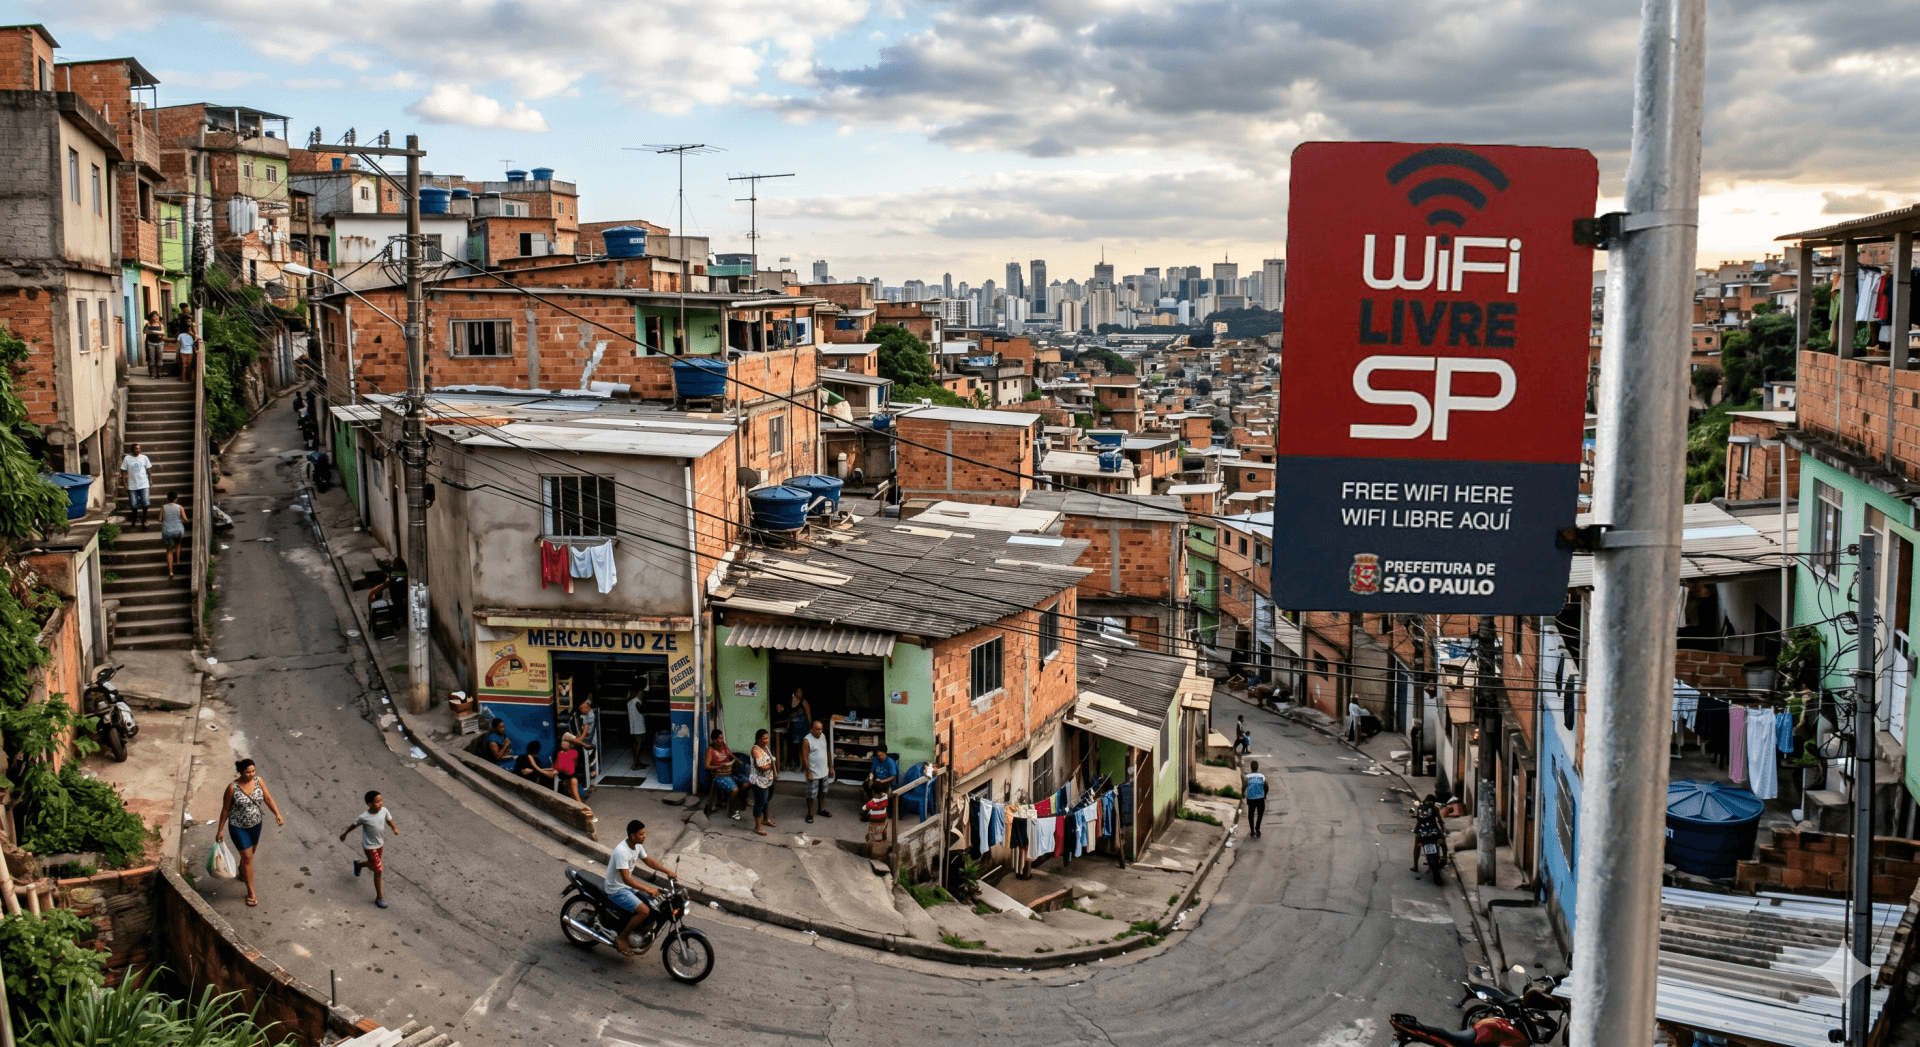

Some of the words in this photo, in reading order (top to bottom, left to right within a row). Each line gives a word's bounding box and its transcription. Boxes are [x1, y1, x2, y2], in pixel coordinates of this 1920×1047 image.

[1362, 235, 1521, 293] WiFi
[1358, 298, 1518, 348] LIVRE
[1350, 355, 1517, 441] SP
[1342, 482, 1398, 501] FREE
[1404, 484, 1448, 502] WIFI
[1455, 485, 1513, 504] HERE
[1342, 508, 1386, 527] WIFI
[1392, 510, 1453, 529] LIBRE
[1458, 508, 1512, 531] AQUÍ
[1385, 560, 1472, 575] PREFEITURA
[1476, 562, 1496, 576] DE
[1383, 573, 1425, 594] SÃO
[1428, 578, 1495, 596] PAULO
[527, 629, 616, 649] MERCADO
[621, 632, 646, 649] DO
[651, 633, 678, 651] ZE
